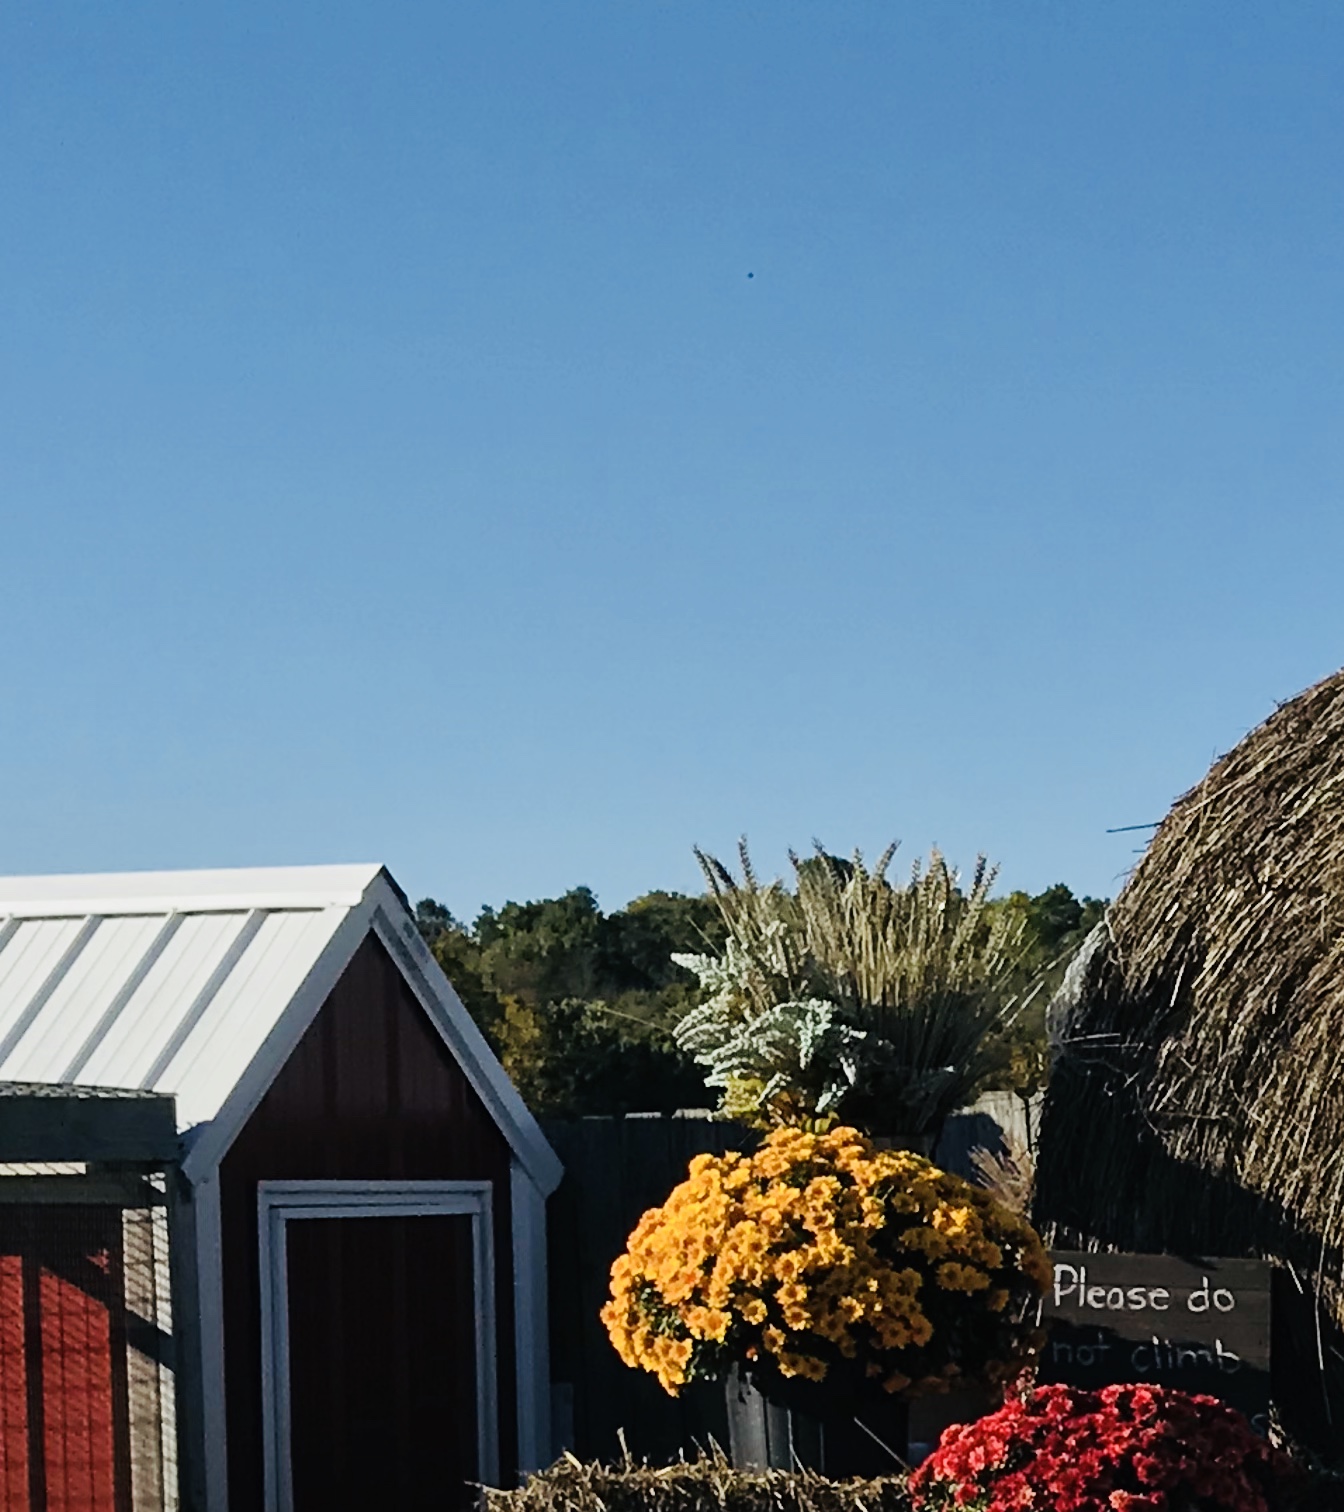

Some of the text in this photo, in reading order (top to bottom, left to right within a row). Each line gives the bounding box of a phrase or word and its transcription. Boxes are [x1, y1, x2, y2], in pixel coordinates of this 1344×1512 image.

[1053, 1264, 1236, 1313] Please do
[1052, 1331, 1240, 1374] not climb
